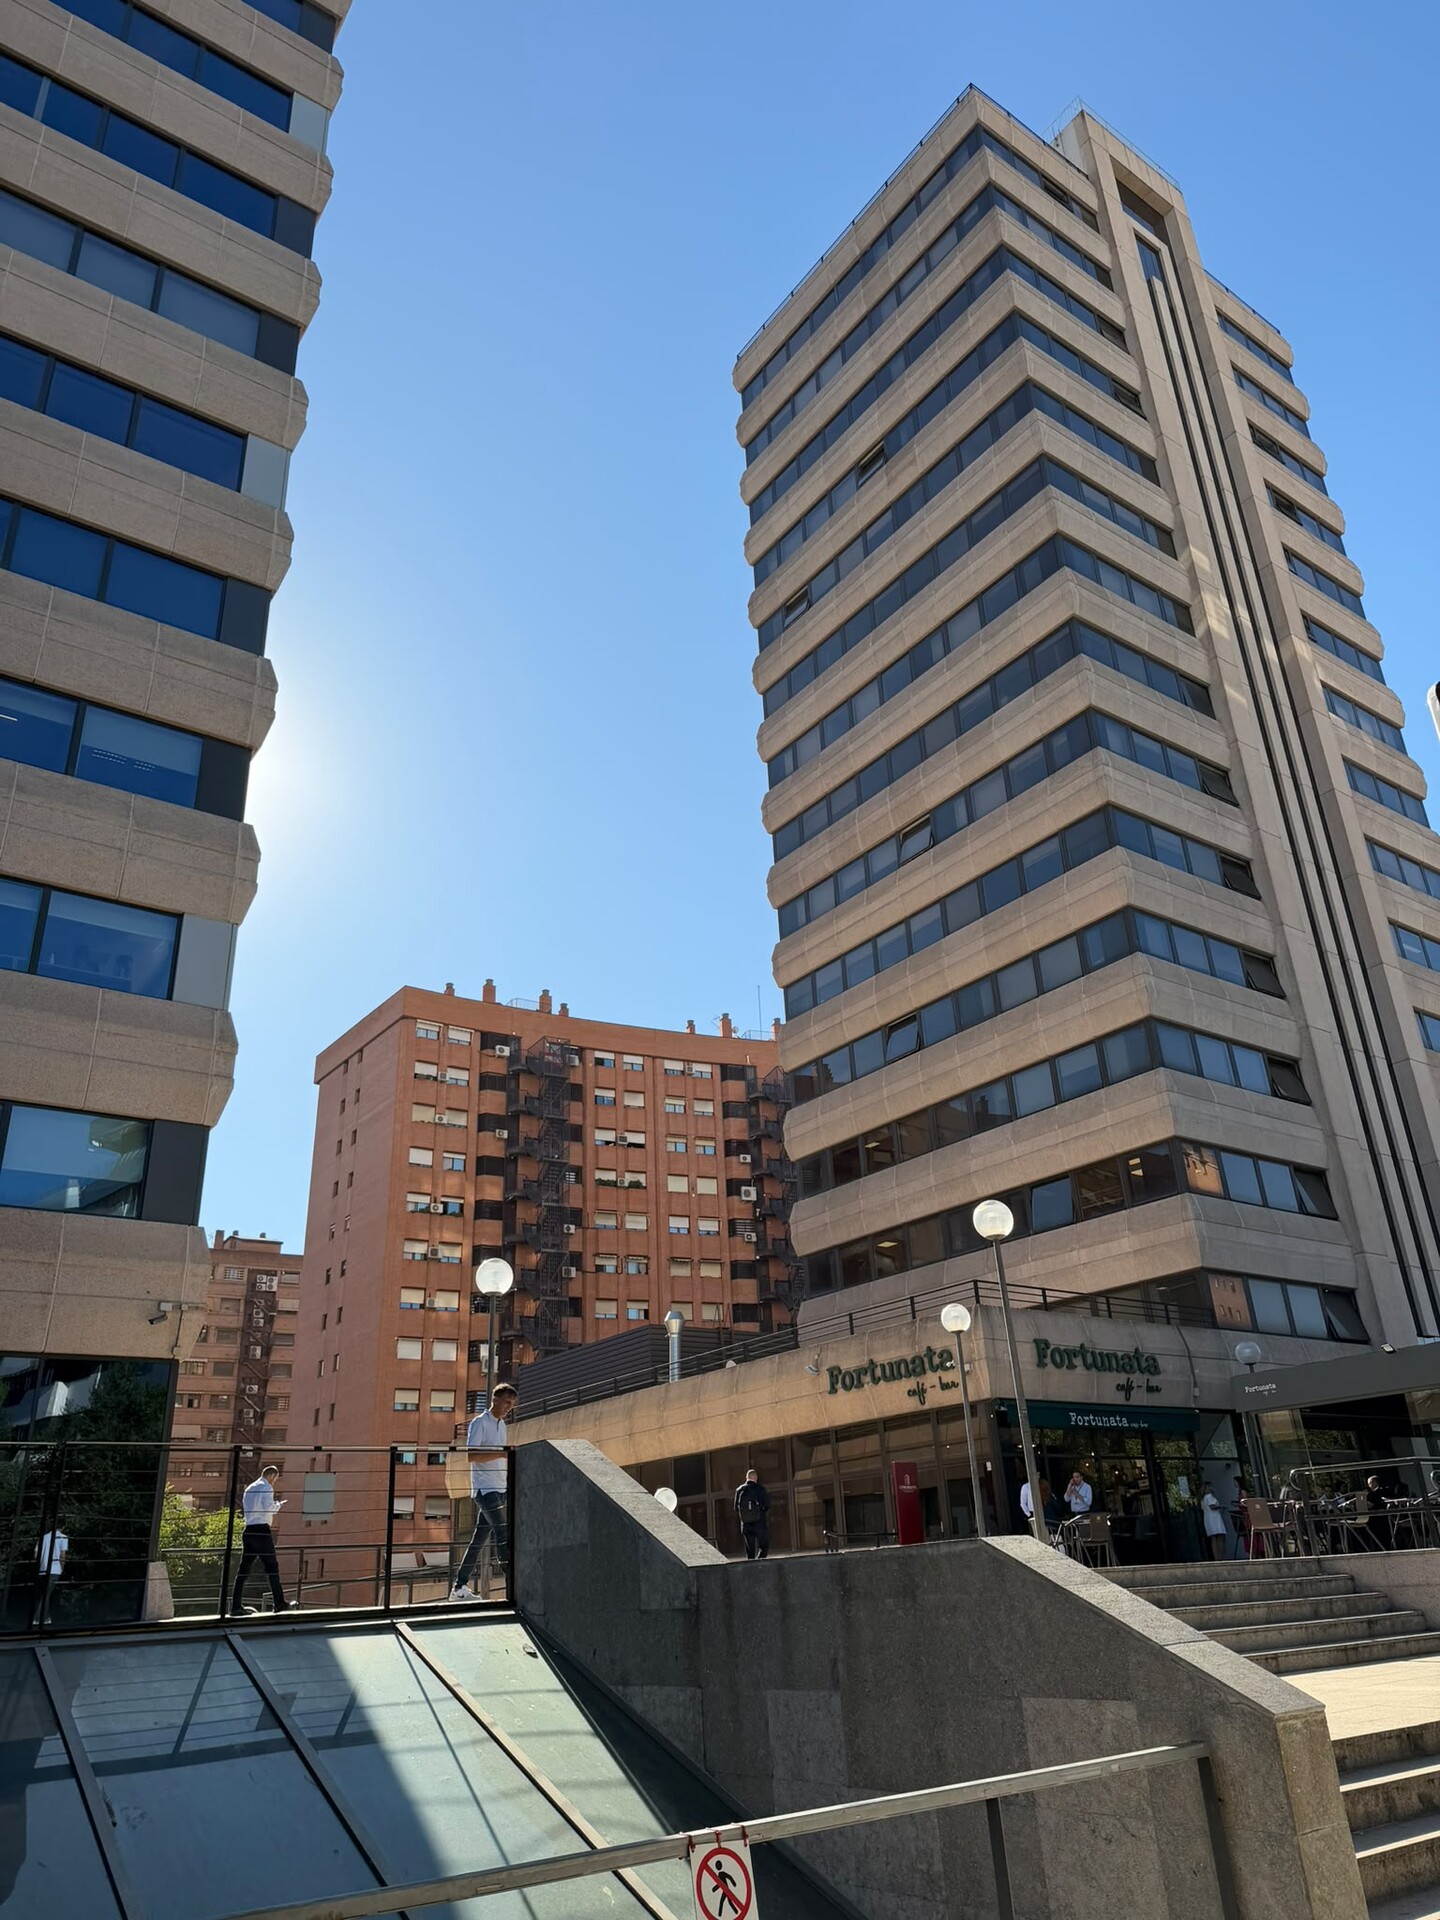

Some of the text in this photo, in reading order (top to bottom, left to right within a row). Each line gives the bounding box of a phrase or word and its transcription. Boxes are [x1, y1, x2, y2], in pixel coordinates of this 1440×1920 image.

[826, 1345, 956, 1395] Fortunata
[1032, 1338, 1162, 1376] Fortunata
[907, 1381, 927, 1405] café
[938, 1376, 960, 1391] bar
[1069, 1412, 1129, 1427] Fortunata
